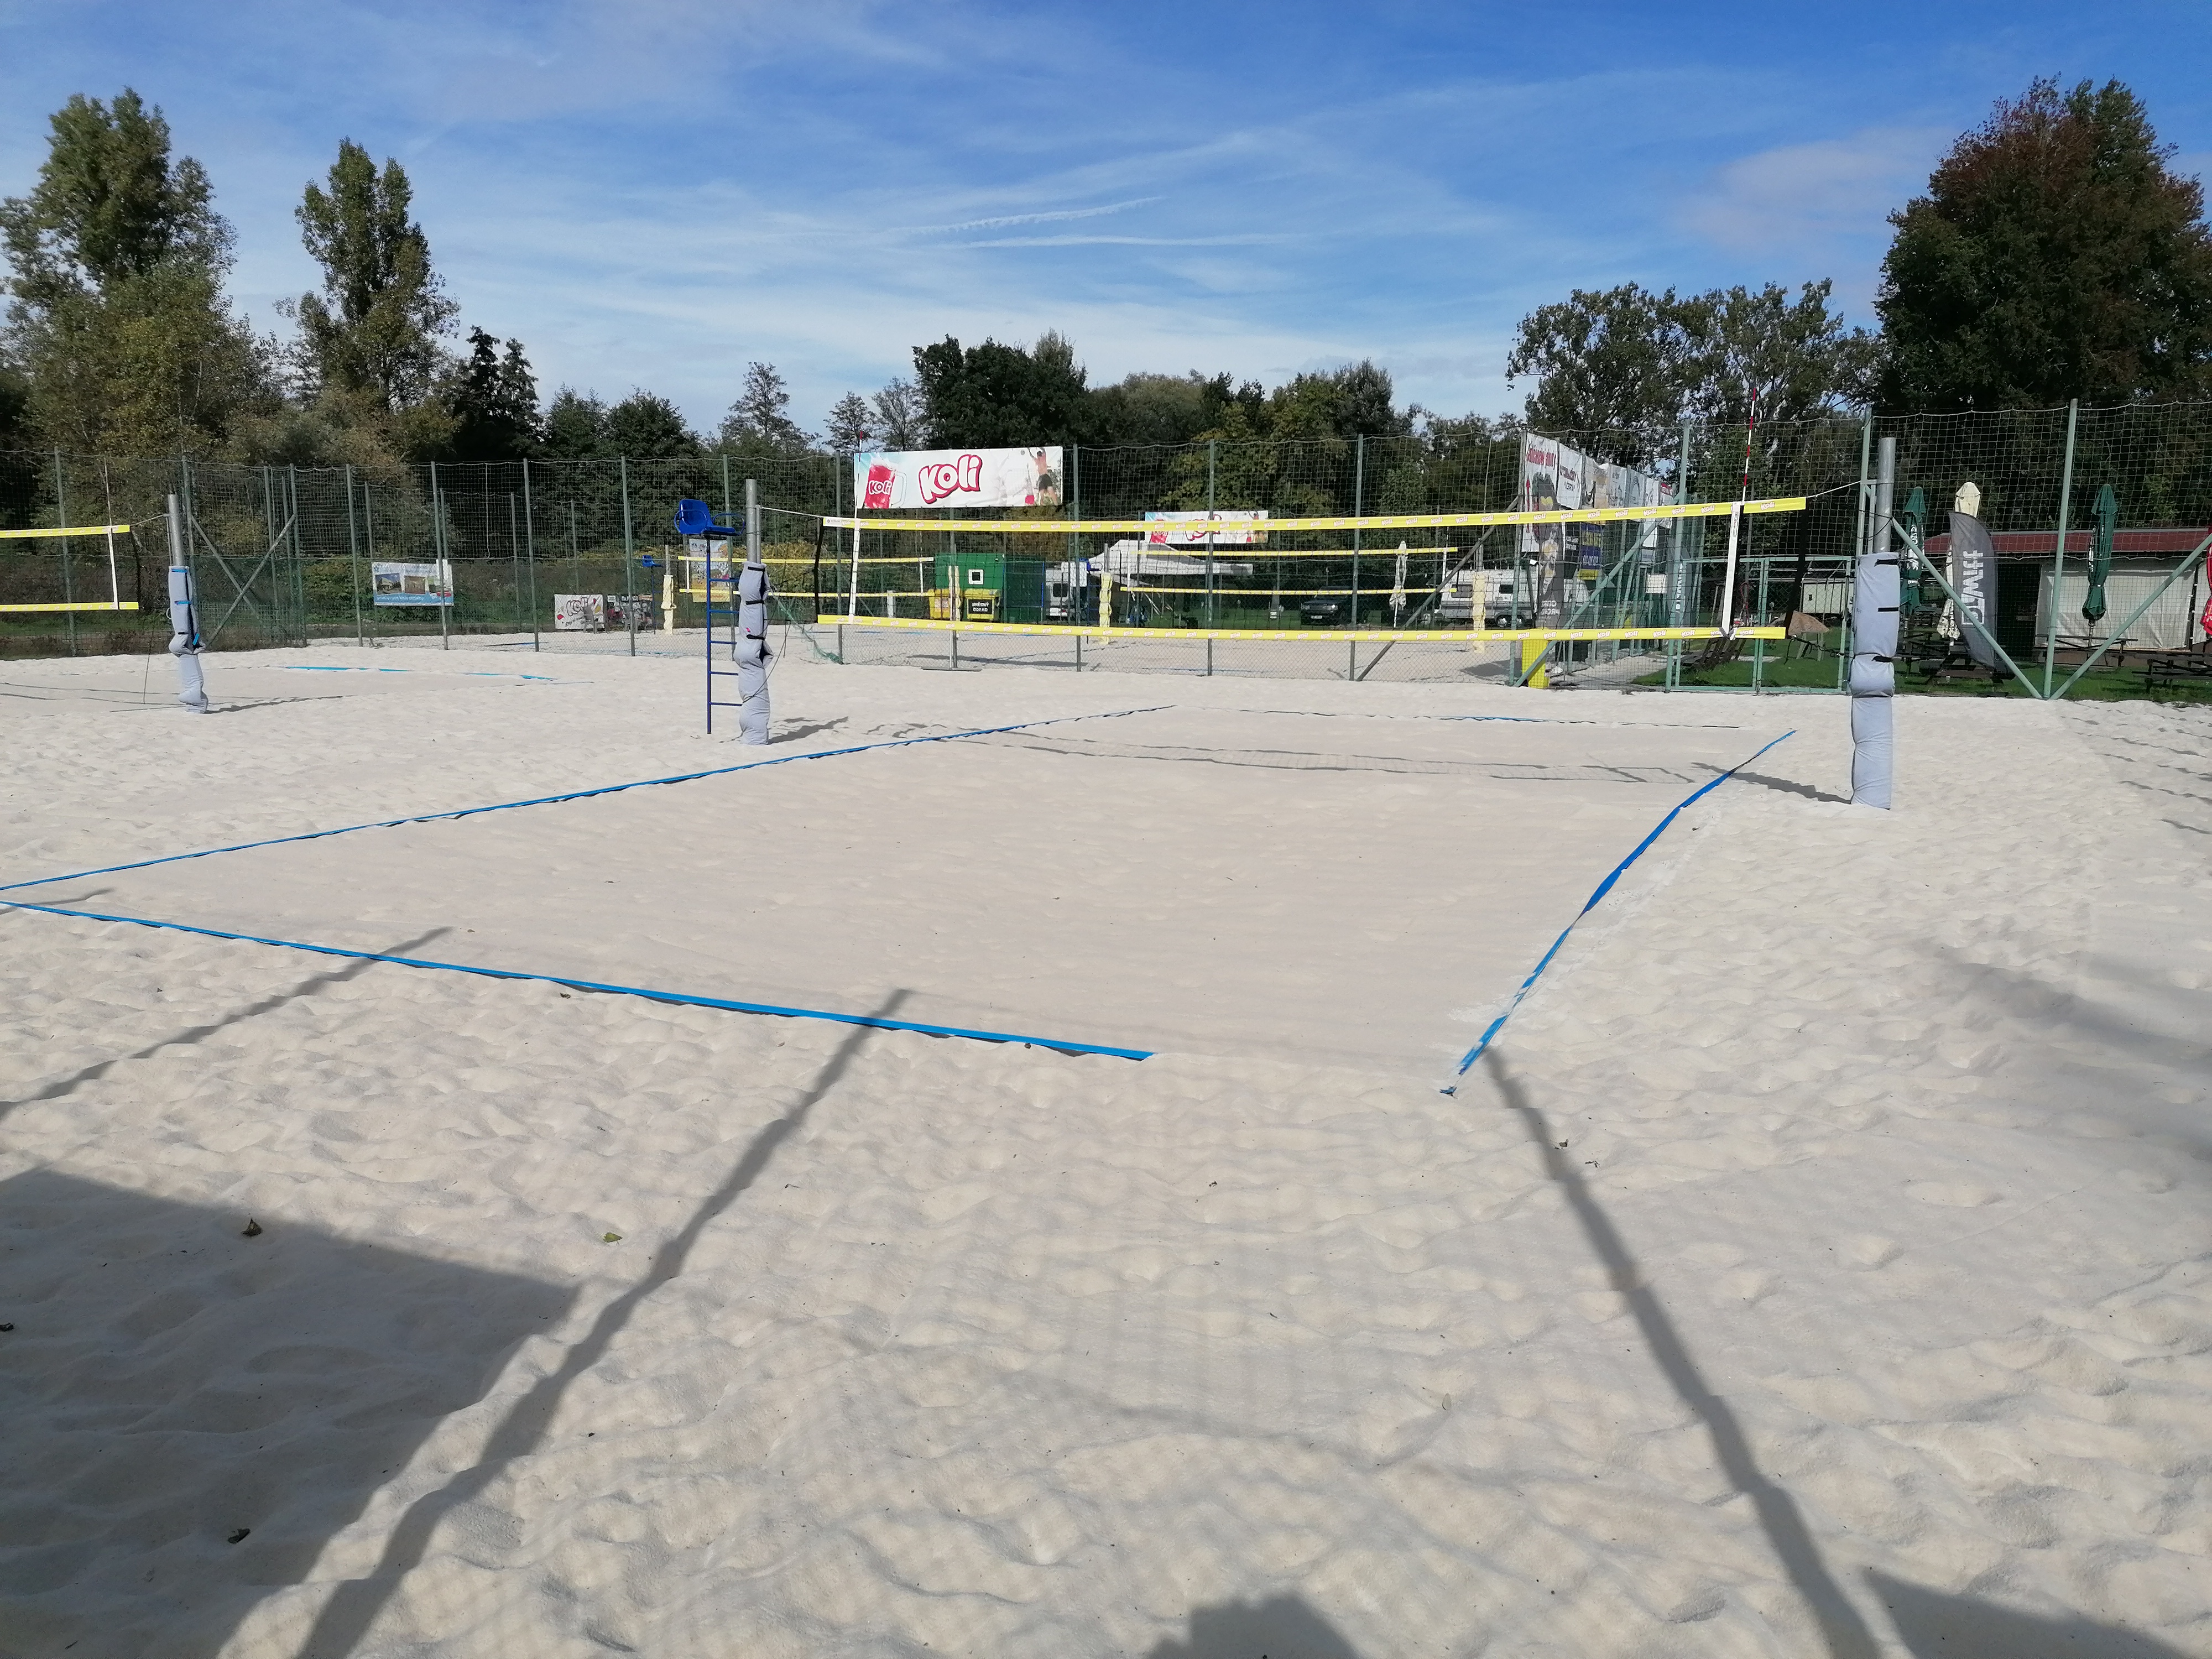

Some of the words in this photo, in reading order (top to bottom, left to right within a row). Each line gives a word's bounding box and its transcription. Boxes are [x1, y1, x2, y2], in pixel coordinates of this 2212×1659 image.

[868, 479, 892, 495] Koli
[919, 453, 983, 504] Koli
[1587, 510, 1601, 519] Koli
[1615, 509, 1629, 517] Koli
[1671, 506, 1686, 514] Koli
[1700, 504, 1715, 513] Koli
[1760, 502, 1775, 510] Koli
